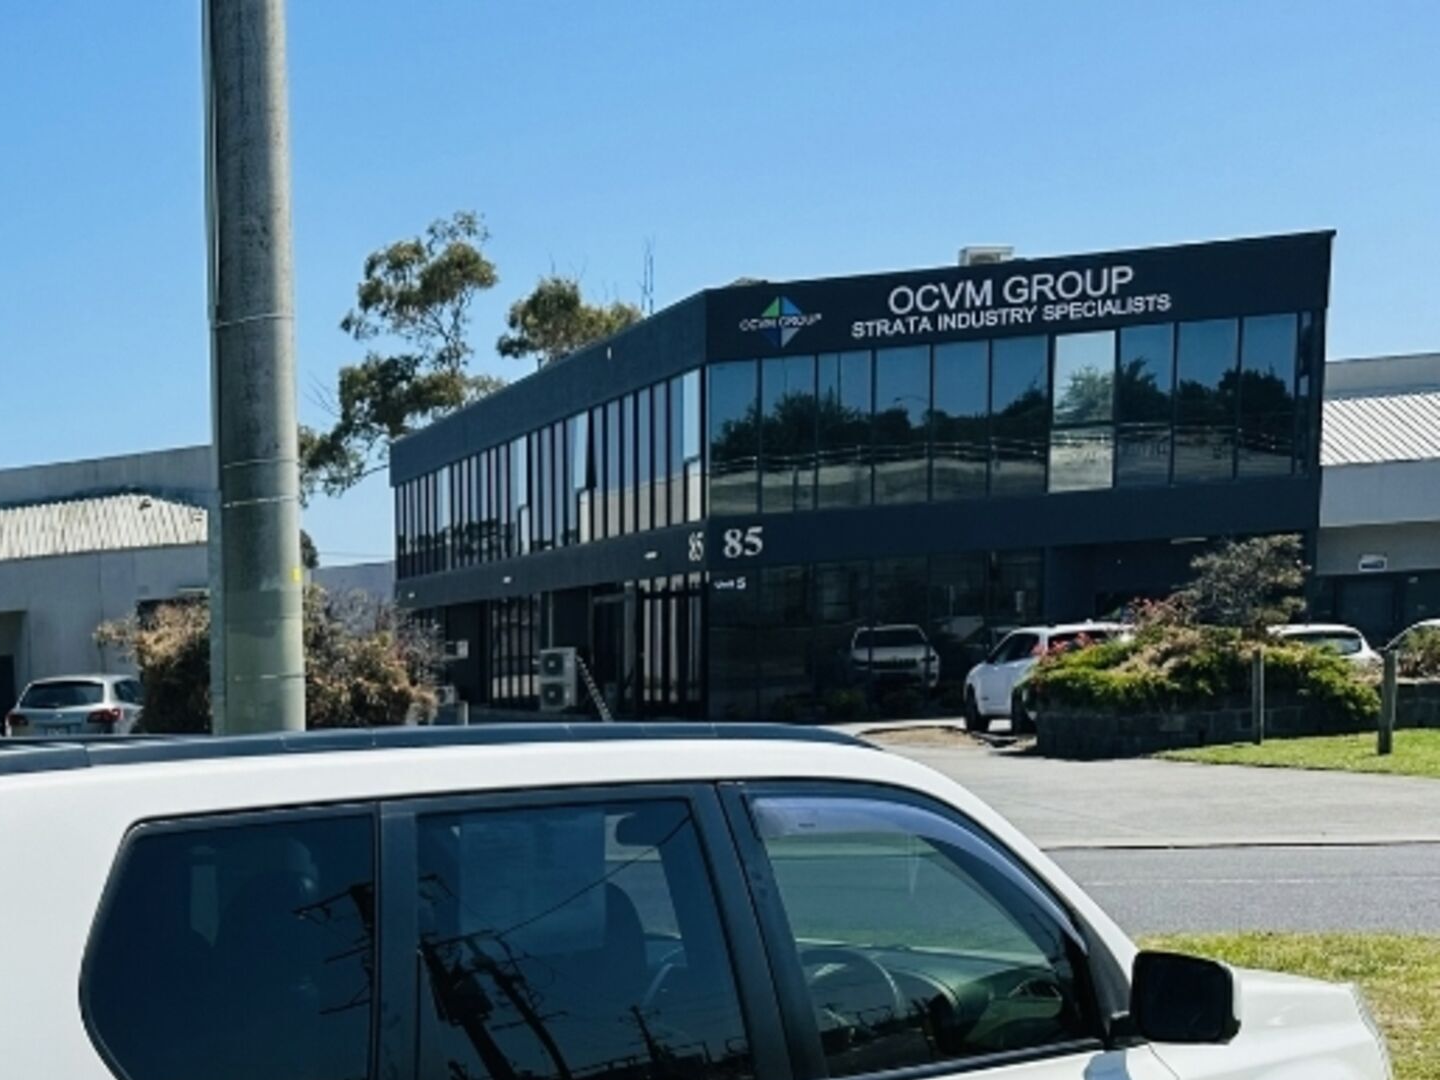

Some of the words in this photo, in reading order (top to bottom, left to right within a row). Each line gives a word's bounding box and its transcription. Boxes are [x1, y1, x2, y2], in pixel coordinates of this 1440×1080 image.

[888, 279, 993, 314] OCVM
[1003, 265, 1135, 304] GROUP
[851, 316, 934, 339] STRATA
[937, 305, 1037, 332] INDUSTRY
[1042, 293, 1173, 322] SPECIALISTS
[723, 526, 764, 558] 85
